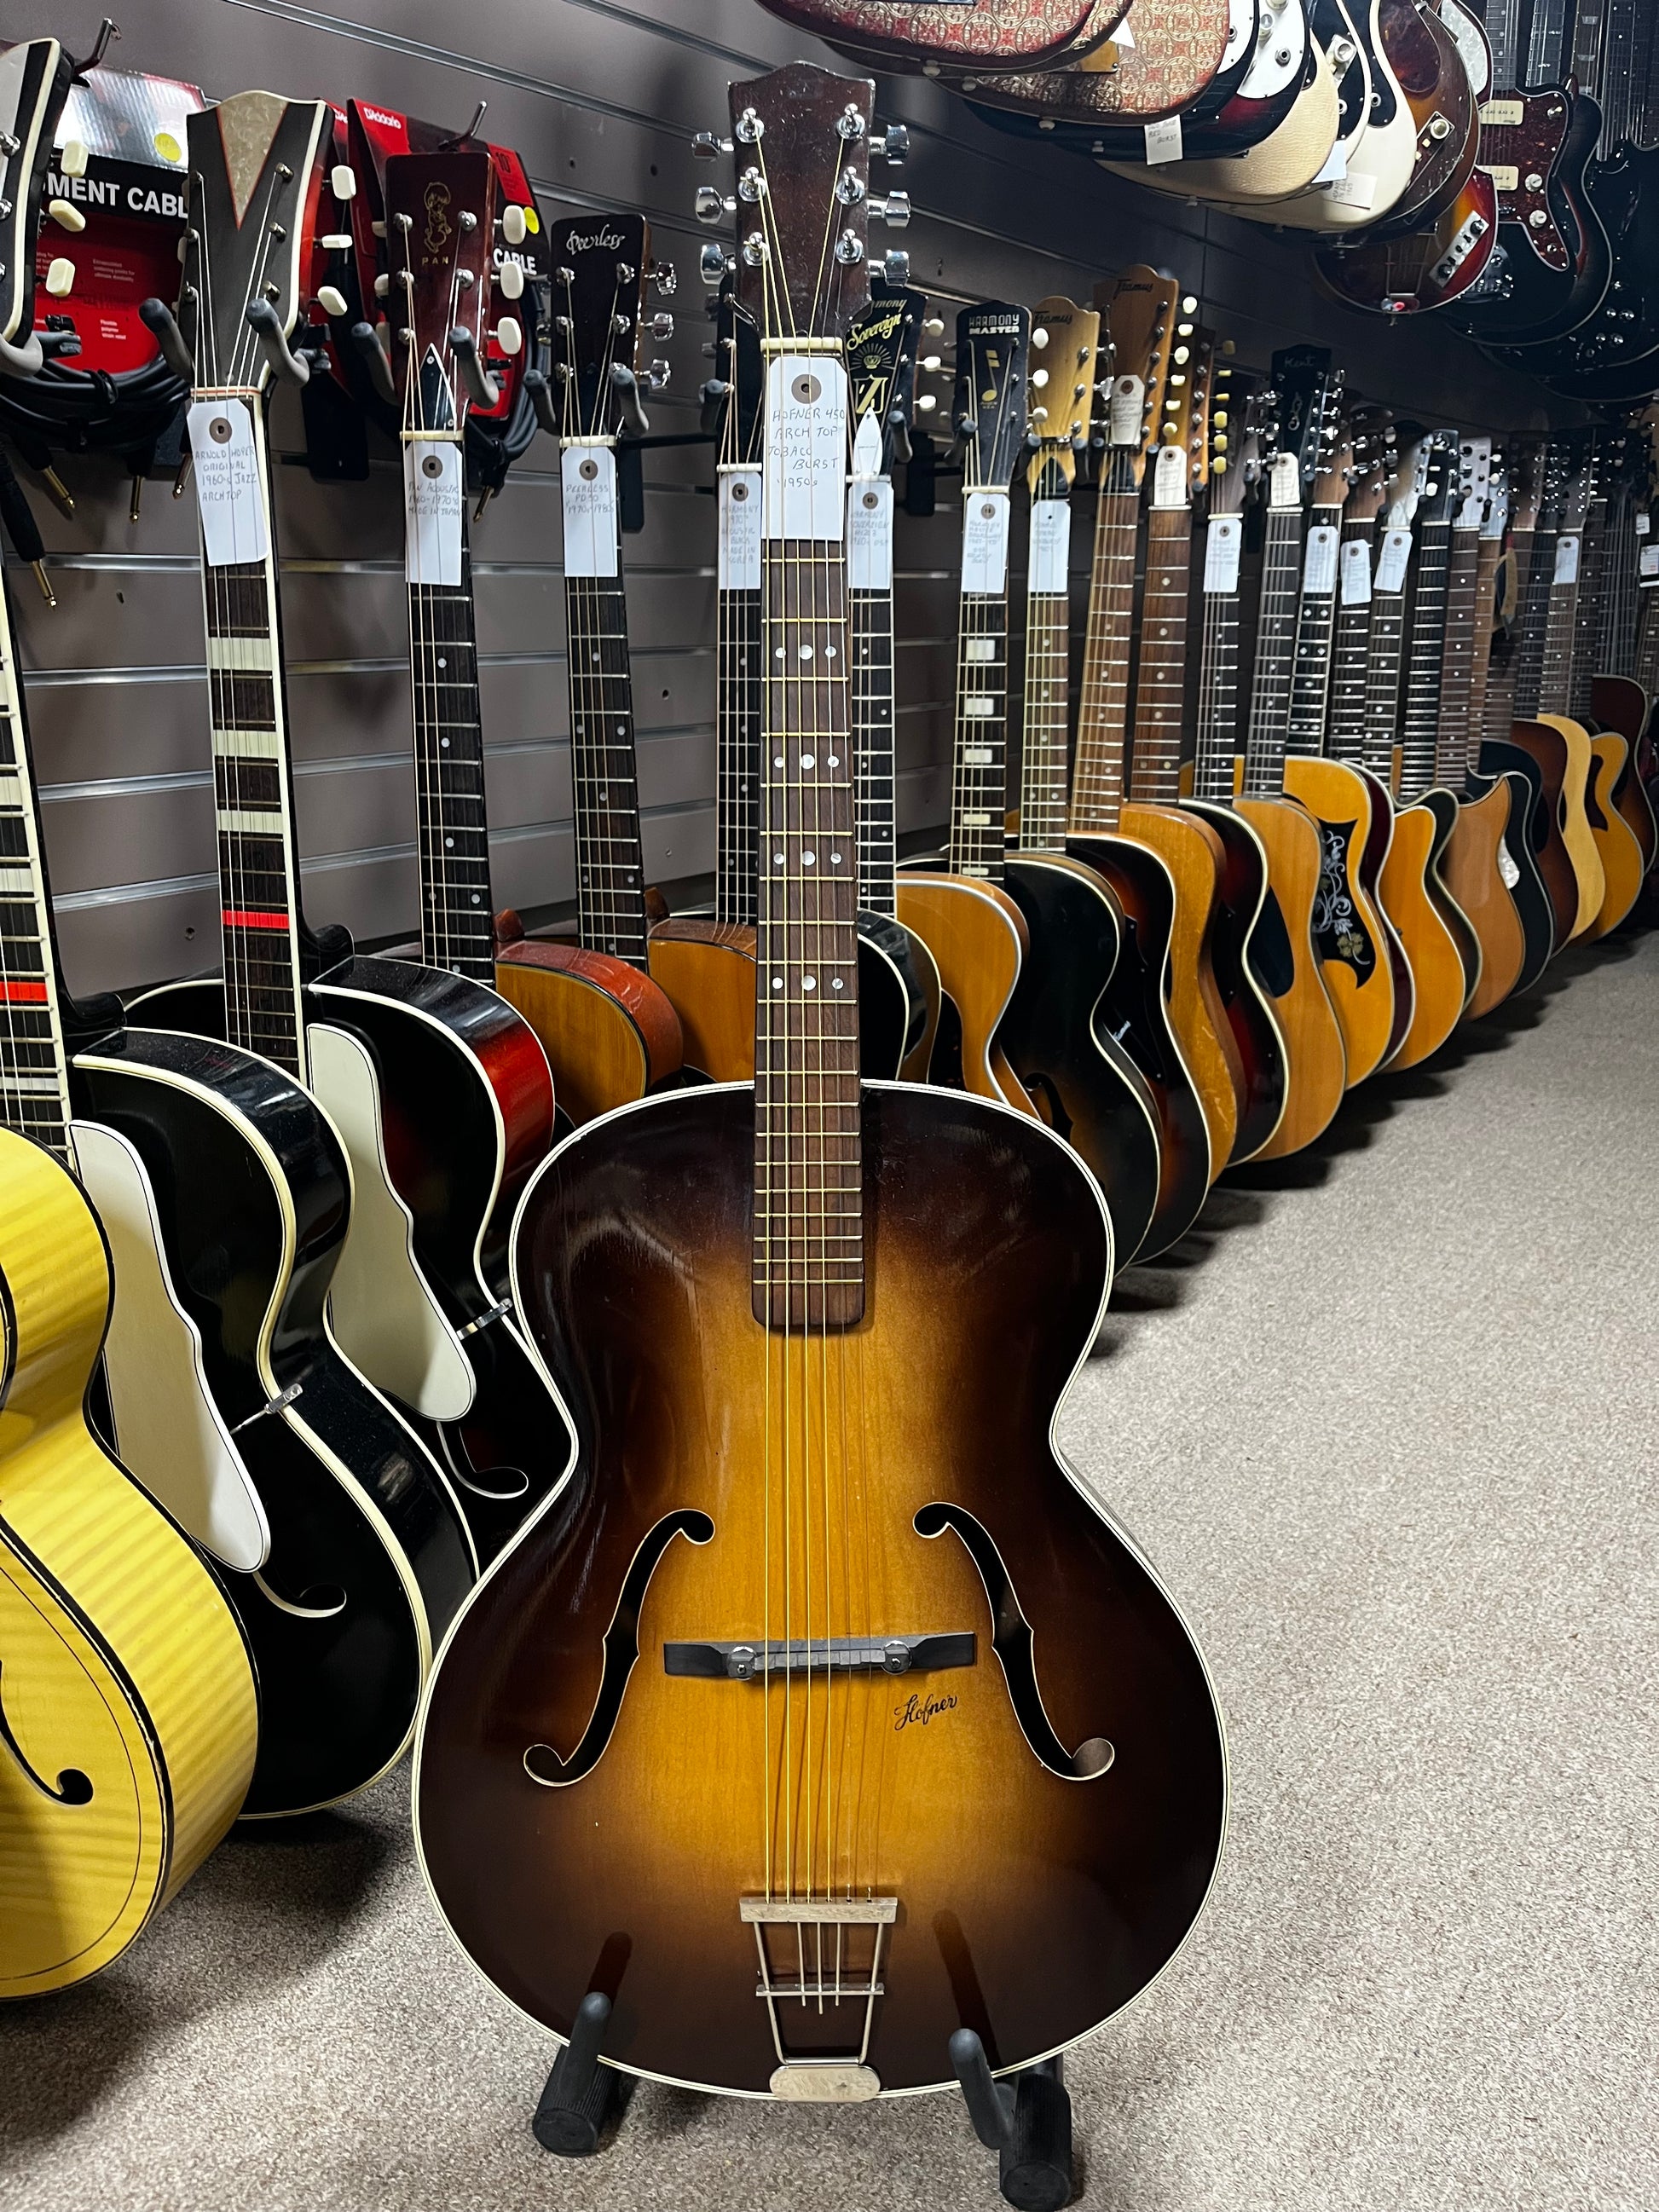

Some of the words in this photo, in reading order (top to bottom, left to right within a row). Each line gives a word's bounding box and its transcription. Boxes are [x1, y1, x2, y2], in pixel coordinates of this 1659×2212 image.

[43, 173, 120, 206] MENT
[565, 223, 626, 256] Peerless
[421, 256, 449, 265] PAN
[872, 299, 908, 313] mony
[969, 314, 1020, 326] HARMONY
[1034, 310, 1072, 325] Framus
[846, 313, 902, 350] Sovereign
[969, 326, 1020, 334] MASTER
[772, 407, 821, 422] HOFNER
[825, 407, 845, 419] 450
[775, 427, 810, 440] ARCH
[817, 426, 838, 437] TOP
[195, 450, 227, 460] ARNOLD
[793, 457, 840, 470] BURST
[234, 472, 257, 484] JAZZ
